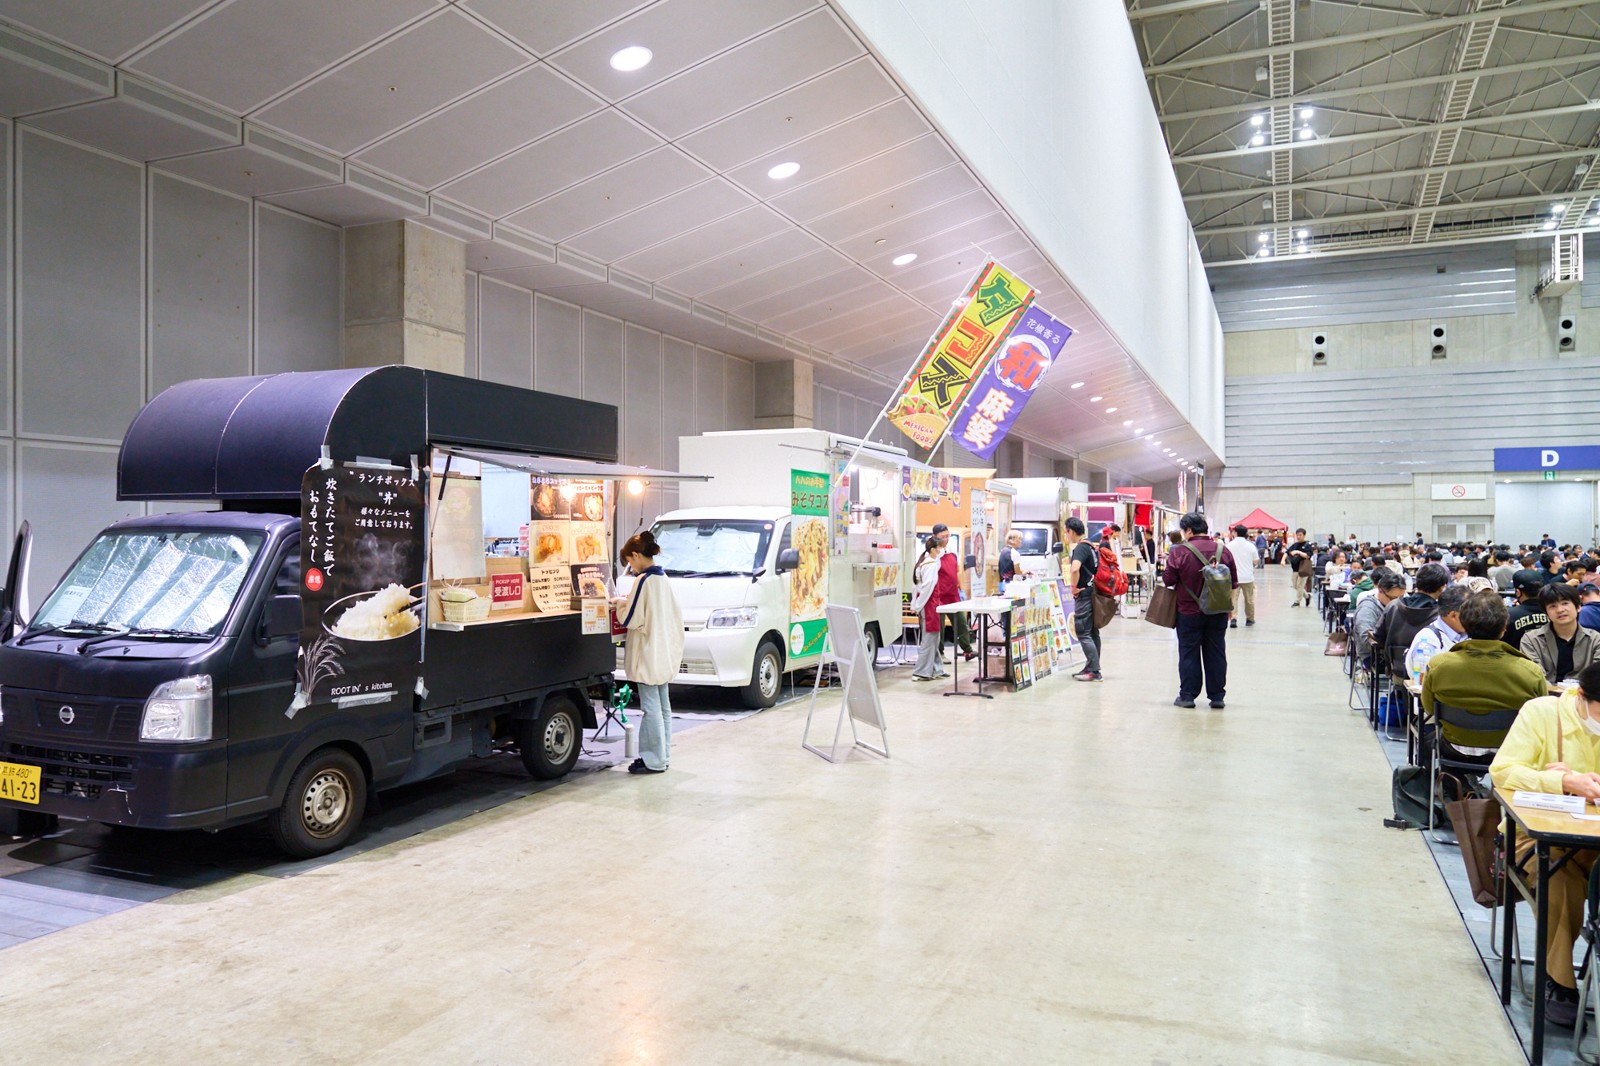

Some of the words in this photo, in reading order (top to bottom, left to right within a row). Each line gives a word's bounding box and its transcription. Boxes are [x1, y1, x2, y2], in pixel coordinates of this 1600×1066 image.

[1026, 318, 1060, 344] 花椒香る
[918, 272, 1024, 410] タコス
[998, 342, 1048, 391] 和
[903, 420, 934, 434] MEXICAN
[912, 431, 934, 444] FOODS
[1541, 450, 1560, 467] D
[791, 491, 829, 509] みそタコス
[360, 507, 411, 518] 様々なメニューを
[308, 490, 320, 563] おもてなし
[494, 585, 521, 597] 受渡し口
[371, 682, 392, 690] kitchen
